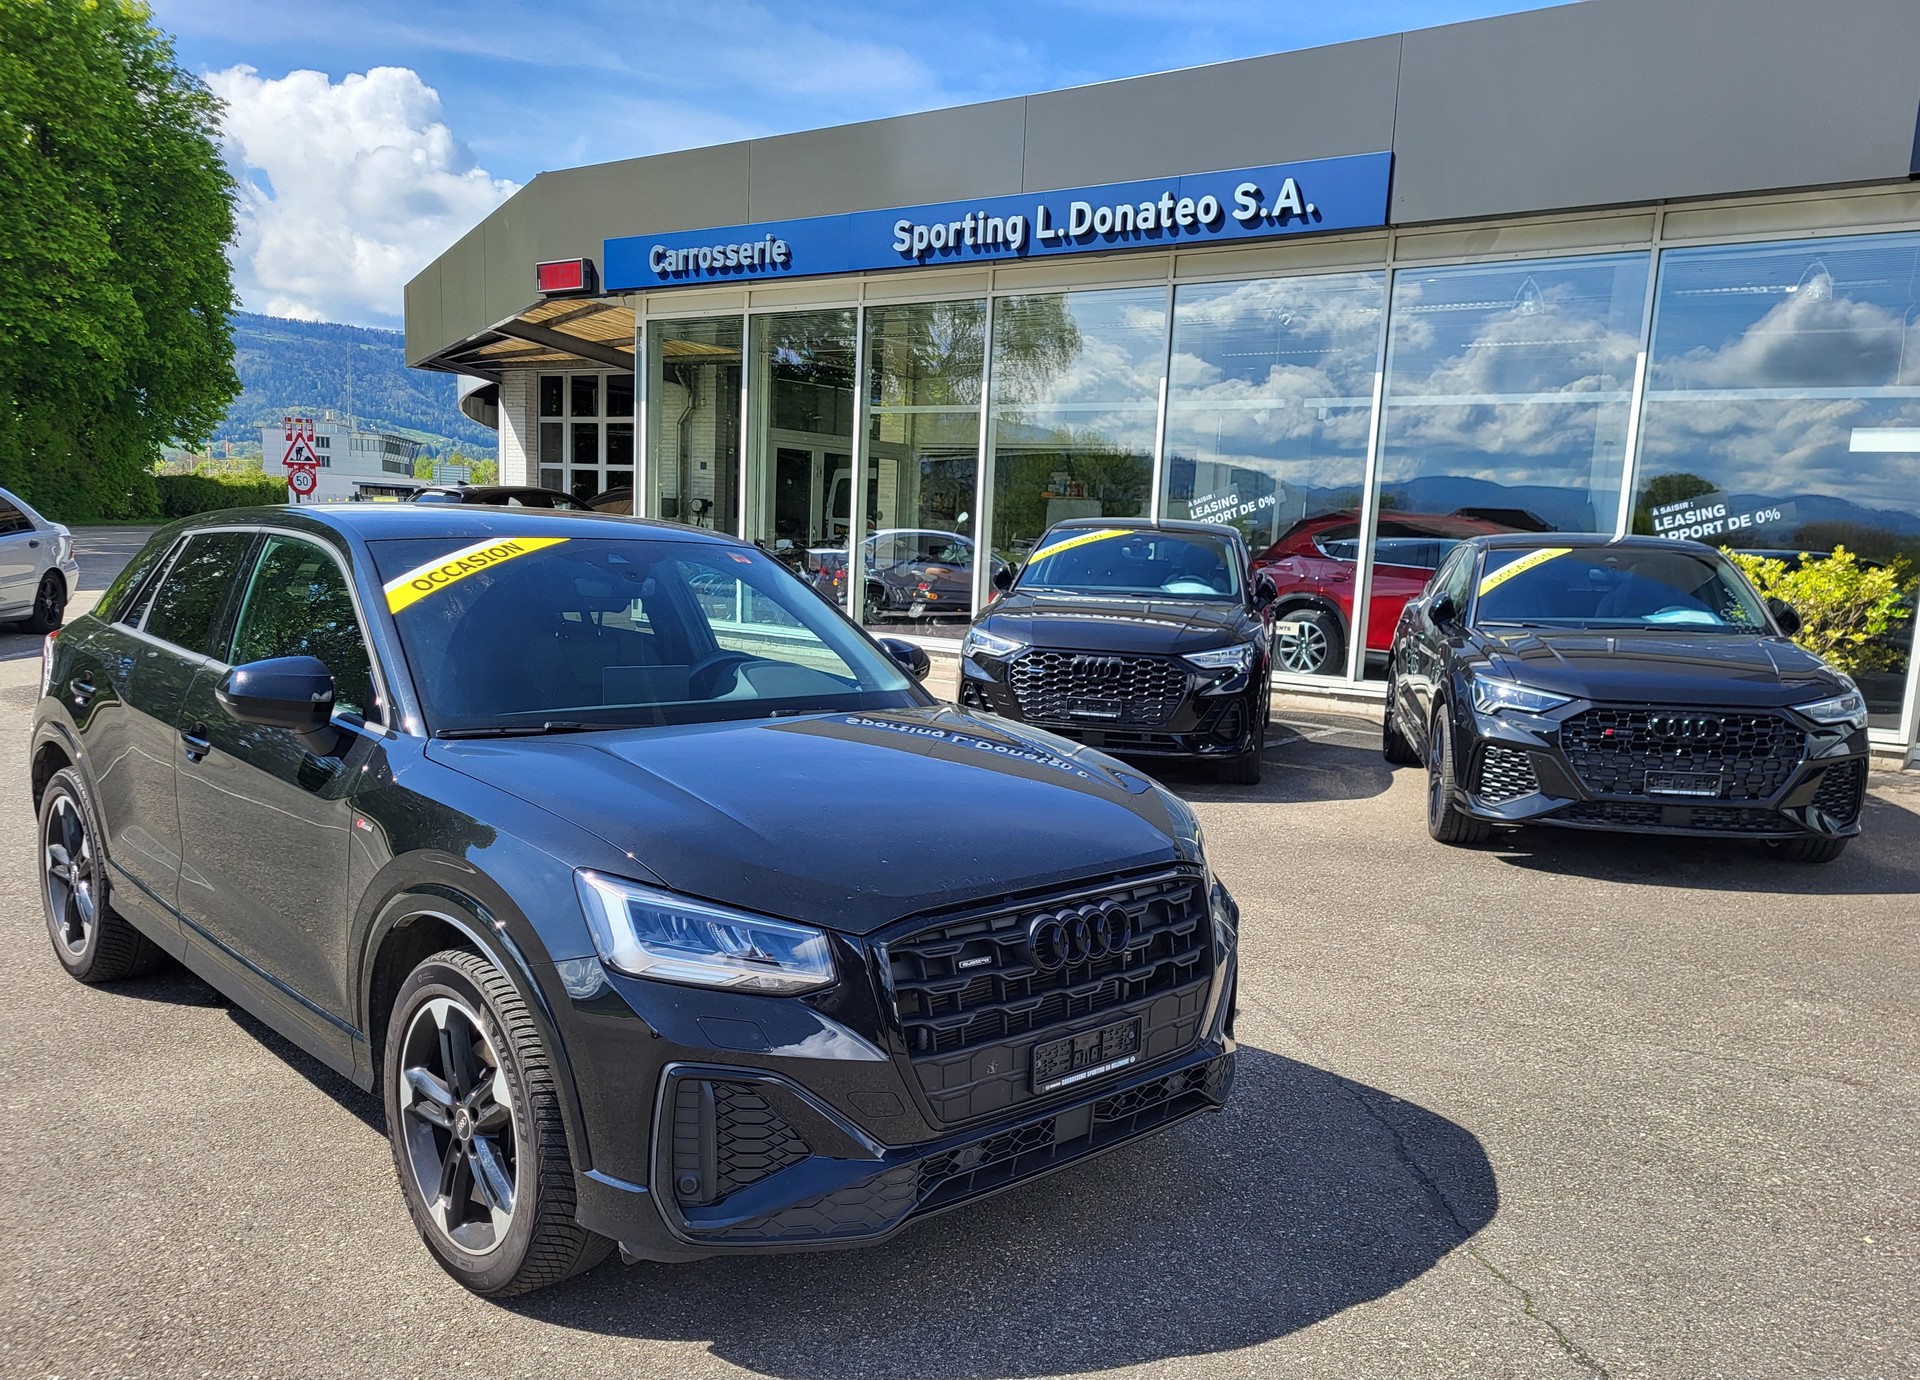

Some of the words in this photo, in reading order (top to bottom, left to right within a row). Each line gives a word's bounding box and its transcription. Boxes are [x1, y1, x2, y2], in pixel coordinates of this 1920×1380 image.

[892, 210, 1024, 258] Sporting
[1036, 190, 1218, 239] L.Donateo
[1232, 177, 1315, 220] S.A.
[649, 233, 787, 273] Carrosserie
[296, 475, 309, 487] 50
[1190, 494, 1238, 519] LEASING
[1240, 501, 1256, 515] DE
[1258, 494, 1276, 509] 0%
[1654, 504, 1726, 531] LEASING
[1660, 501, 1689, 514] SAISIR
[1728, 514, 1752, 530] DE
[1756, 508, 1781, 524] 0%
[1043, 534, 1102, 555] OCCASION
[411, 542, 524, 592] OCCASION
[1491, 552, 1553, 584] OCCASION
[493, 1034, 527, 1138] MICHELIN
